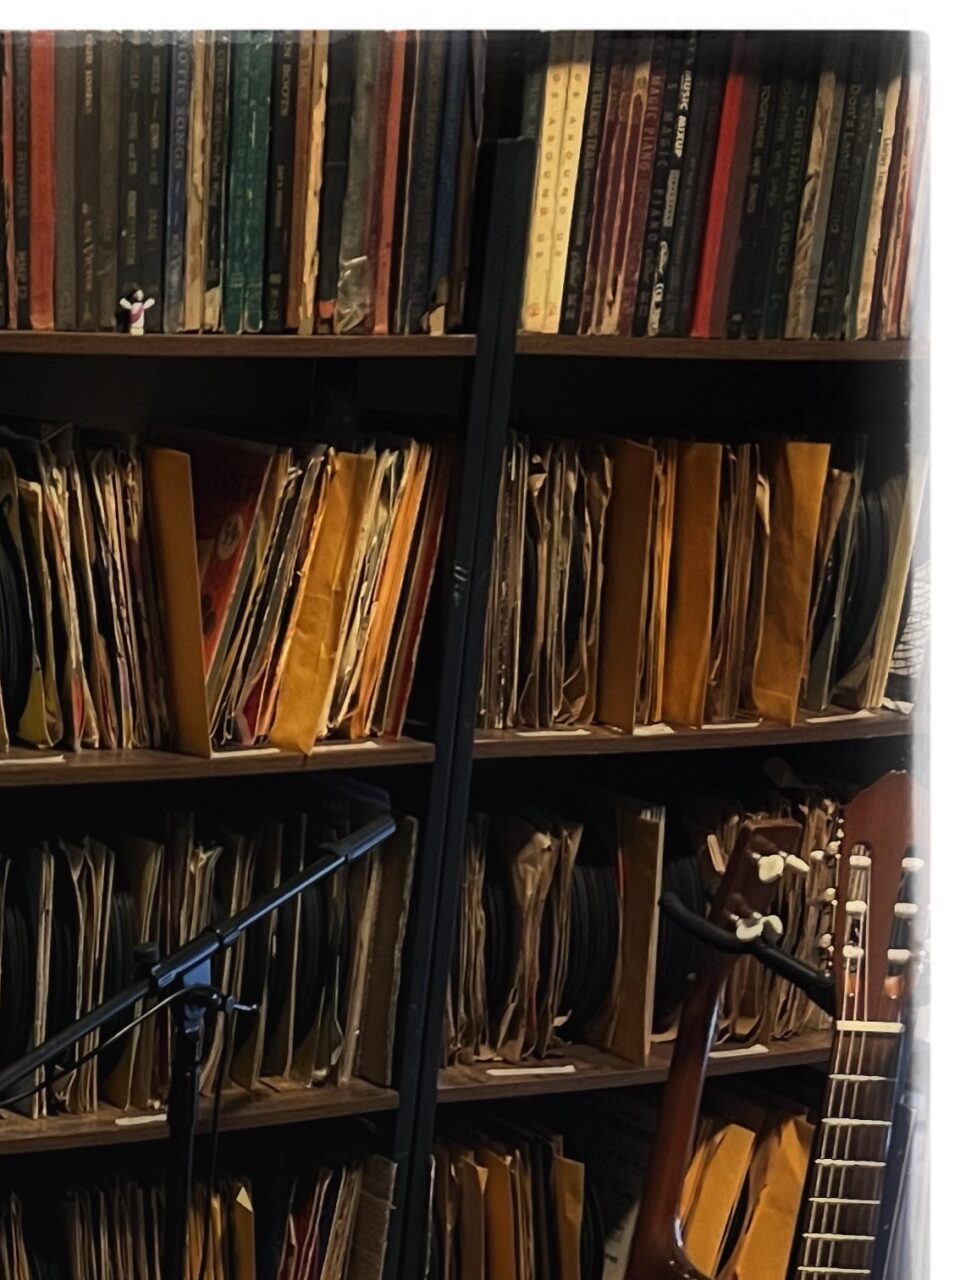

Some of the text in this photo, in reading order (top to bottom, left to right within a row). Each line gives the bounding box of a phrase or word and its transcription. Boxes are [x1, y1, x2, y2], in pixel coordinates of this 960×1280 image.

[280, 63, 292, 117] BOOTS
[679, 69, 693, 112] MUSIC
[754, 83, 772, 149] TOGETHER
[844, 83, 861, 128] Don's
[172, 106, 188, 170] SONGS
[639, 74, 660, 171] MAGIC PIANO
[657, 111, 674, 168] MAGIC
[674, 114, 688, 160] MIXUP
[540, 115, 558, 217] AROUND
[559, 115, 577, 216] AROUND
[750, 155, 762, 177] WE
[776, 104, 808, 275] CHRISTMAS CAROLS
[647, 188, 664, 242] PIANO
[535, 232, 547, 259] US
[554, 231, 564, 258] US
